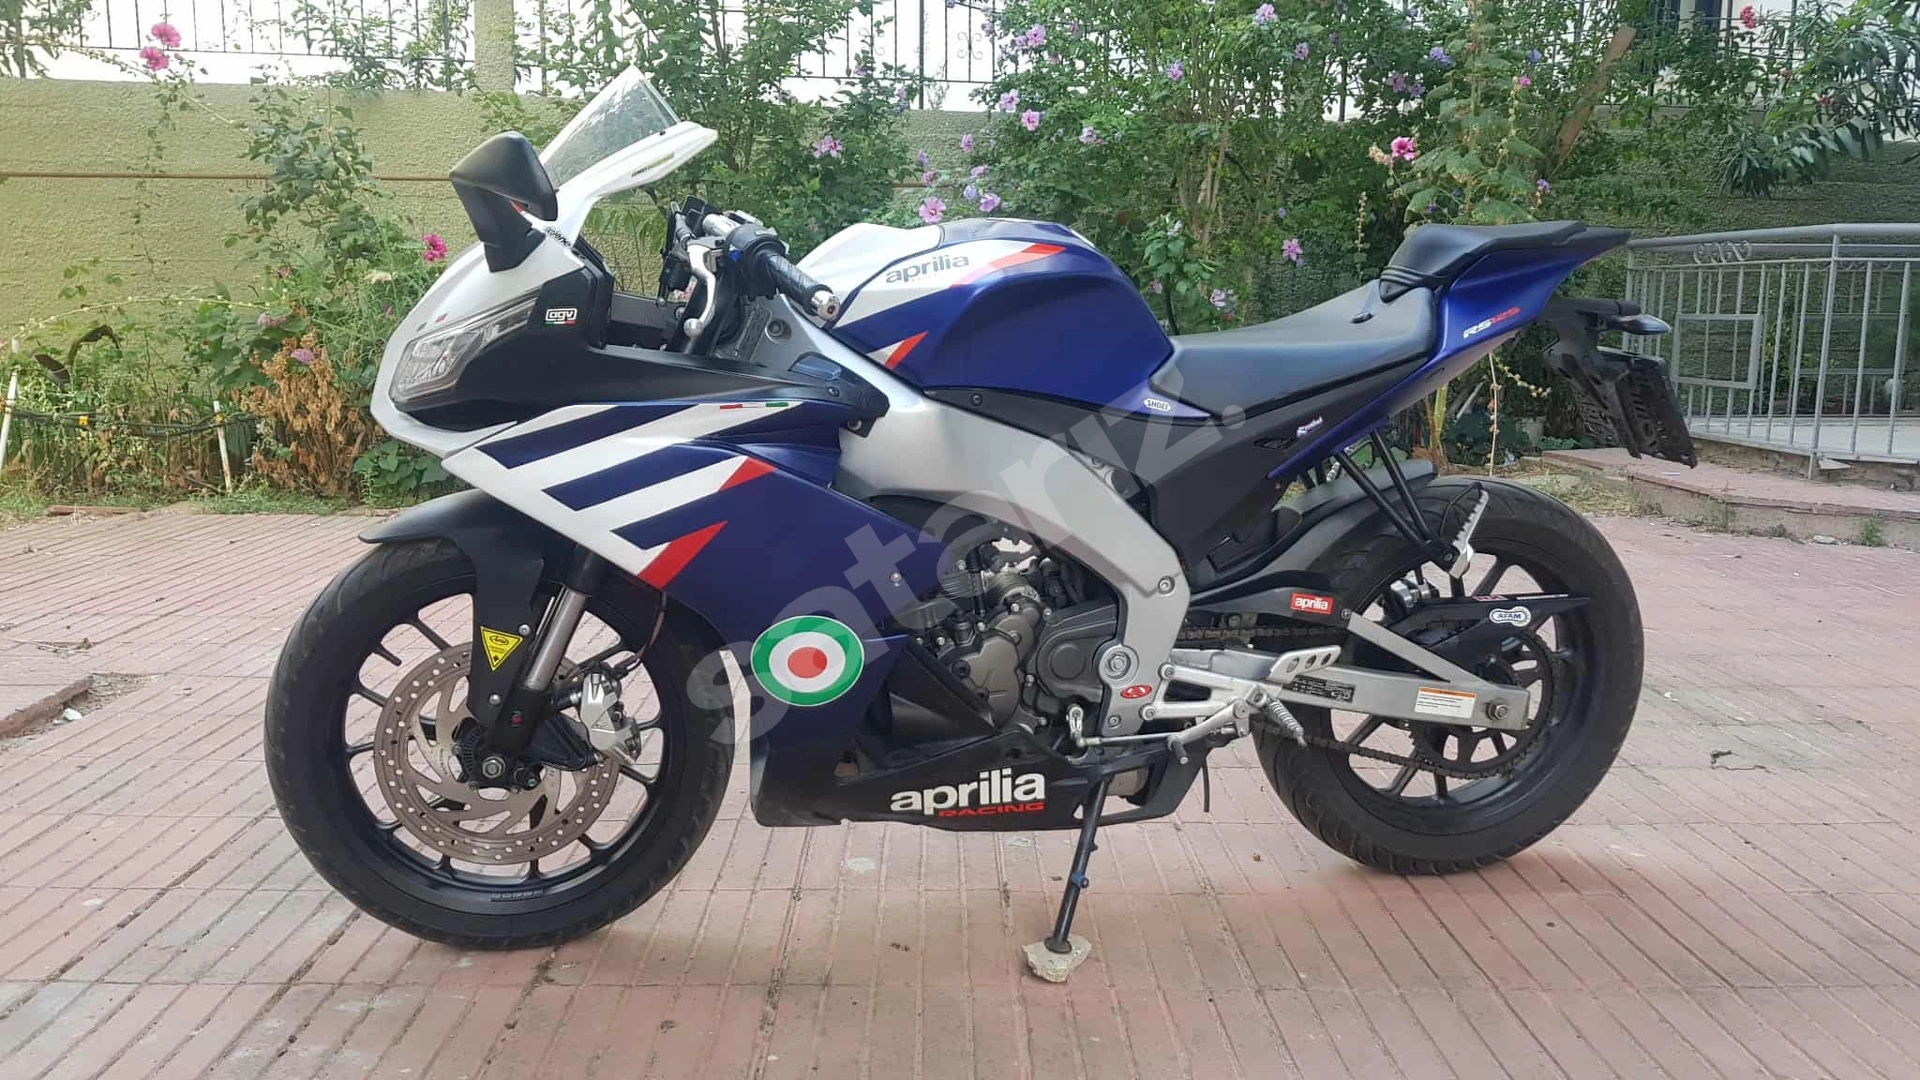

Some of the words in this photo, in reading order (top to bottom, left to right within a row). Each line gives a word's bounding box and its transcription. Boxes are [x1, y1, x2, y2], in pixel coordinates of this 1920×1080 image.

[885, 255, 969, 283] aprilia
[1147, 399, 1169, 410] SHOEI
[1295, 597, 1329, 610] aprilia
[1497, 612, 1522, 620] AFAM
[890, 767, 1046, 815] aprilia
[938, 801, 1046, 817] RACING
